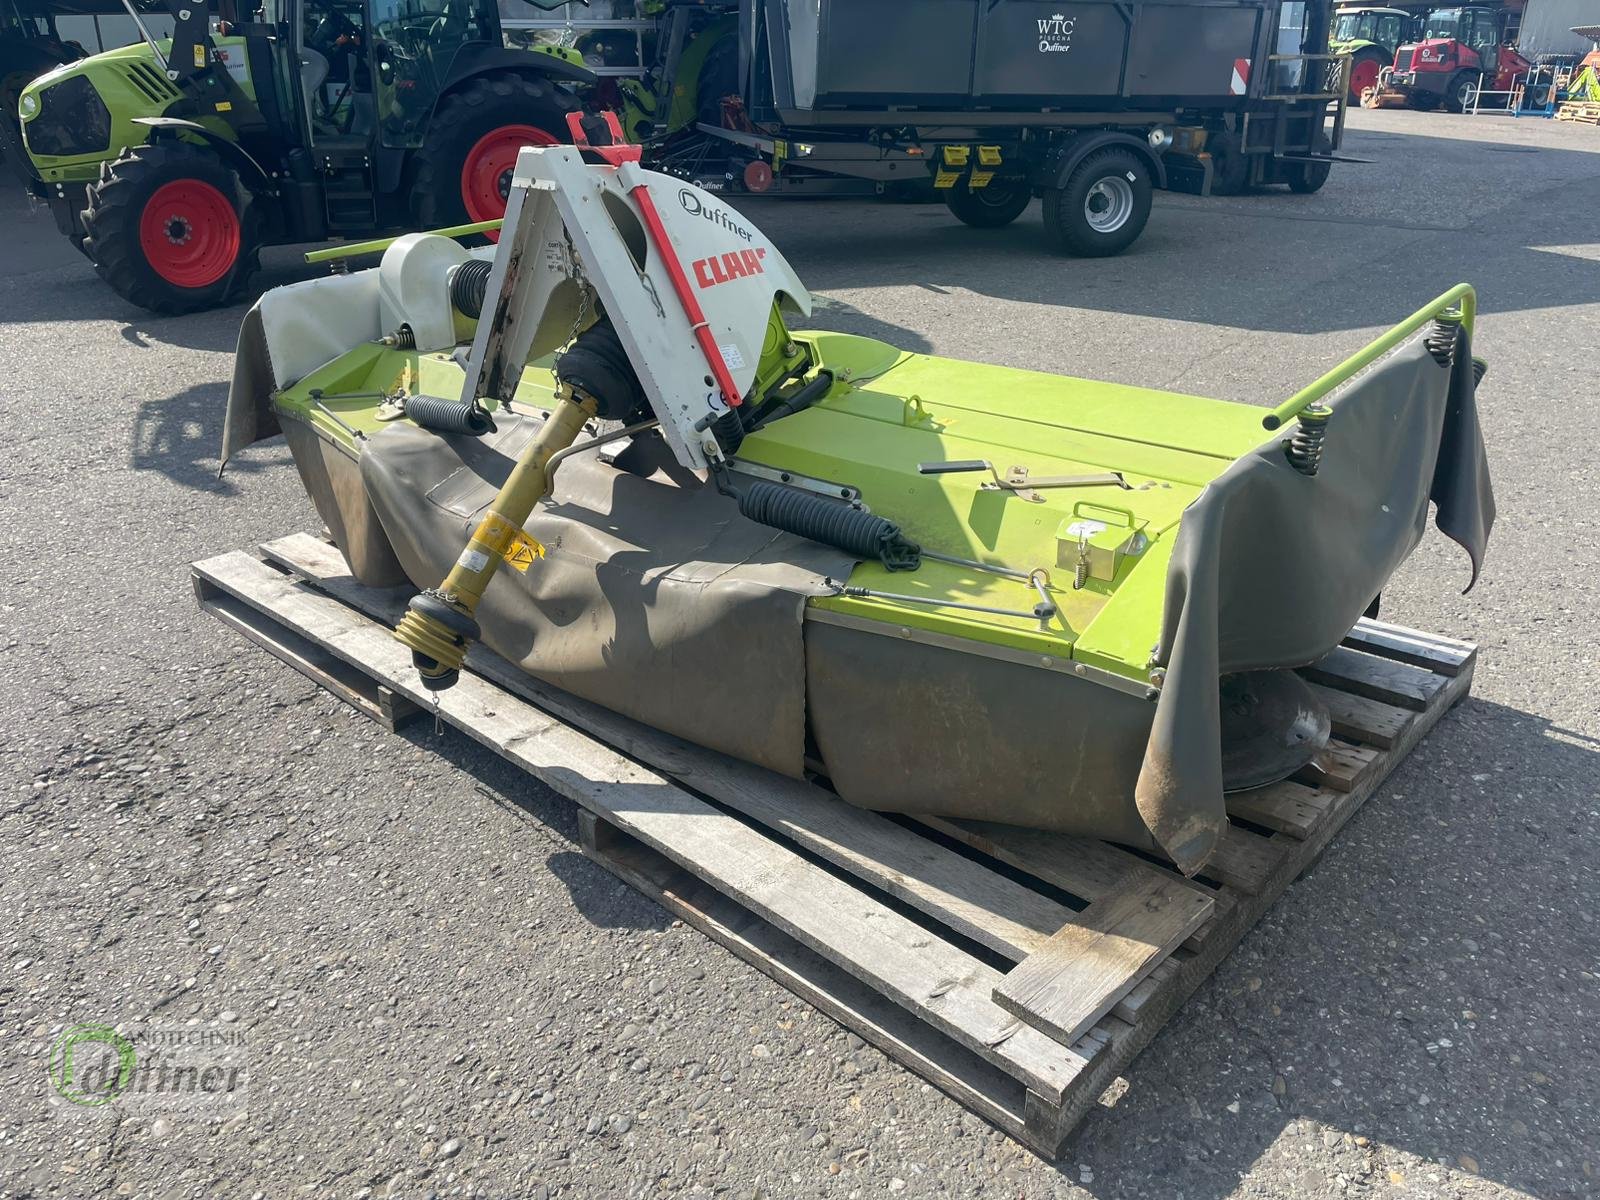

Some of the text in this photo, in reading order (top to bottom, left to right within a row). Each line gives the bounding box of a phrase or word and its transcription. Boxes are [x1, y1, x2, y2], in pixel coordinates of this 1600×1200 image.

[1037, 19, 1073, 34] WTC
[1039, 40, 1069, 52] Duffner
[677, 188, 752, 241] Duffner
